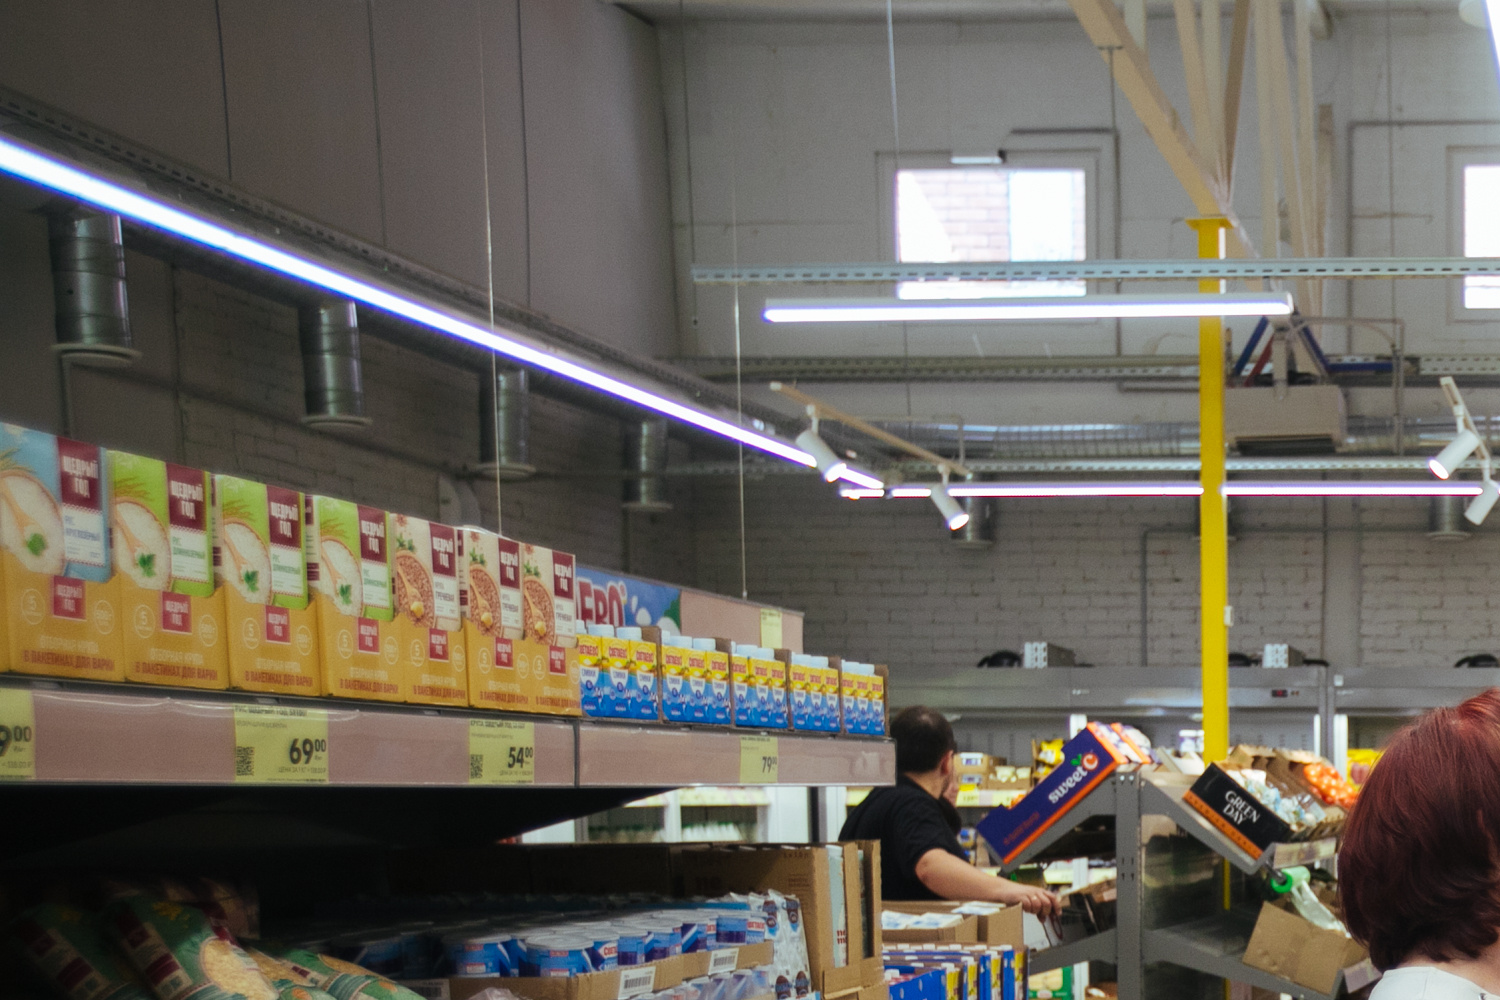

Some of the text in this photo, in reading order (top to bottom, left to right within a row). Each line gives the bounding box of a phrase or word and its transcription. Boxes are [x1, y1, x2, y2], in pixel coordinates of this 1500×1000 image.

[62, 455, 99, 479] ЩЕДРЫЙ
[74, 478, 91, 498] ГОД
[171, 480, 203, 502] ЩЕДРЫЙ
[181, 501, 196, 520] ГОД
[270, 502, 299, 521] ЩЕДРЫЙ
[279, 521, 292, 538] ГОД
[361, 519, 385, 537] ЩЕДРЫЙ
[369, 537, 380, 554] ГОД
[1048, 765, 1088, 804] sweet
[1223, 804, 1247, 825] DAY
[1225, 790, 1260, 823] GREEN
